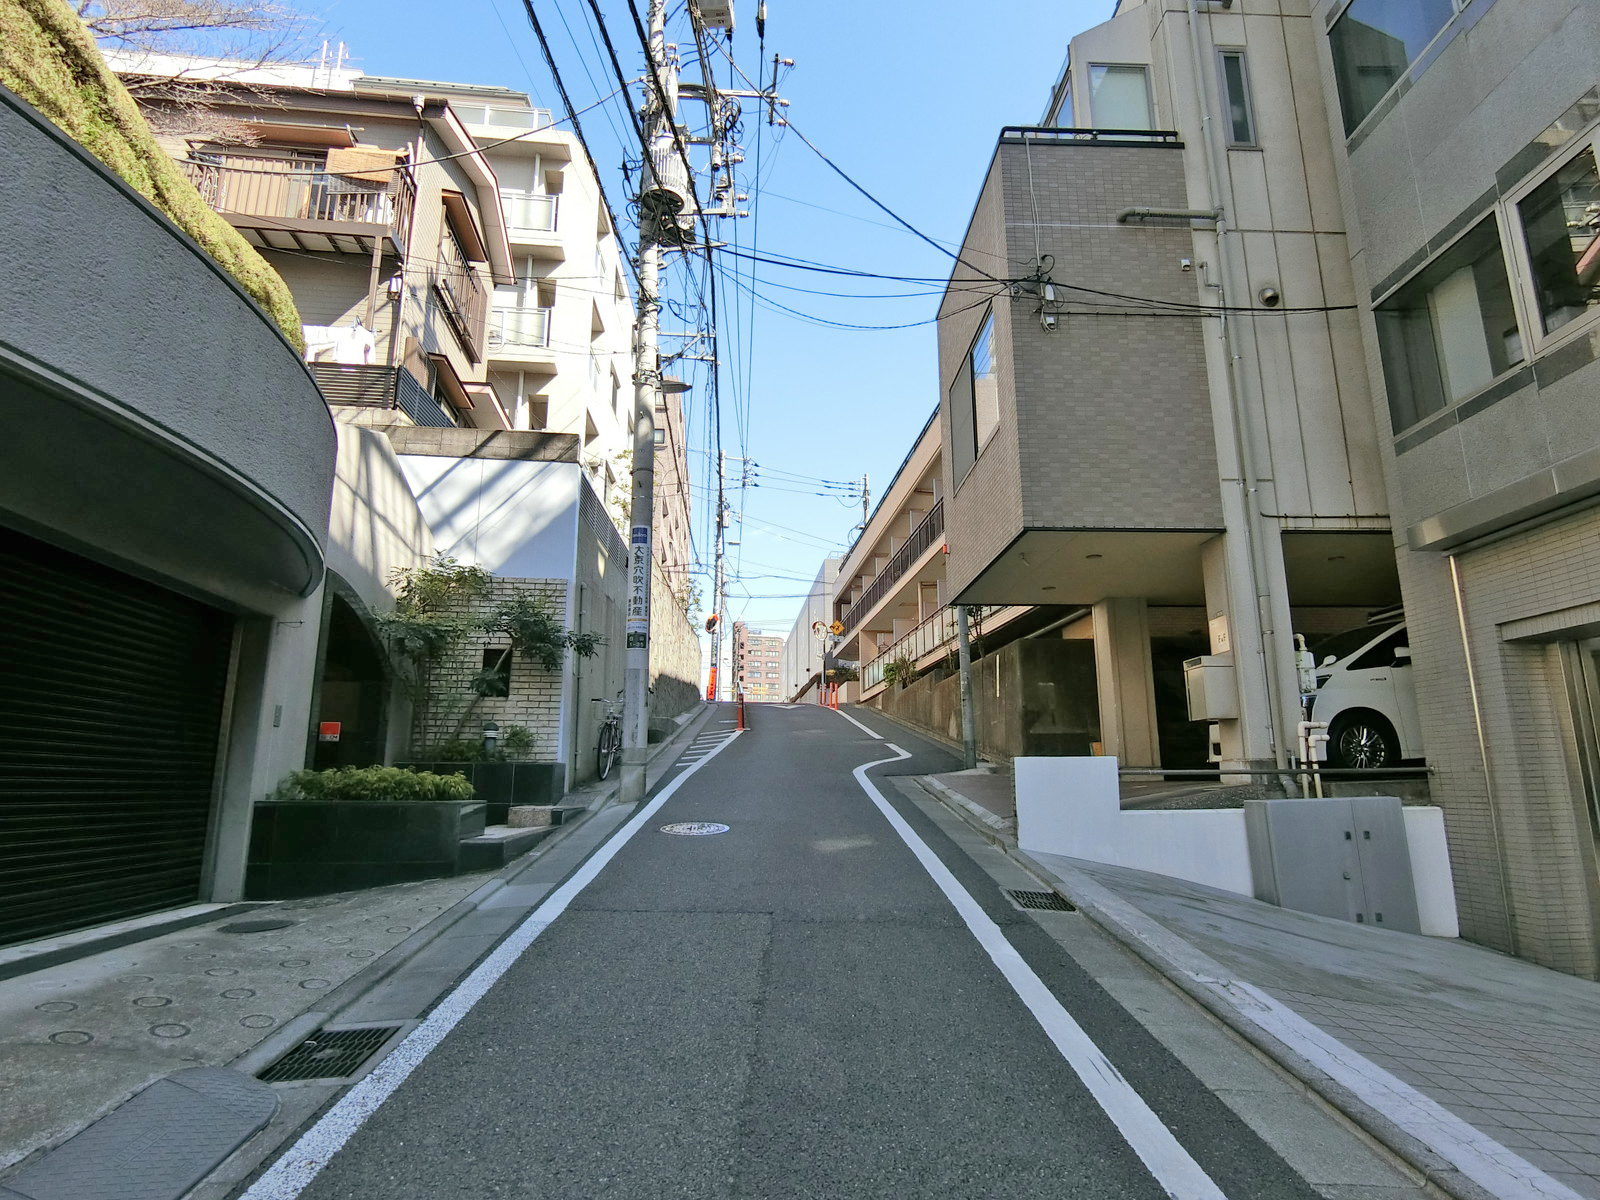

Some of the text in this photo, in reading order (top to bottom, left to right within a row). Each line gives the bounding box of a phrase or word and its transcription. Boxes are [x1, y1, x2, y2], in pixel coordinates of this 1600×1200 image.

[632, 546, 644, 616] 大京穴吹不動産
